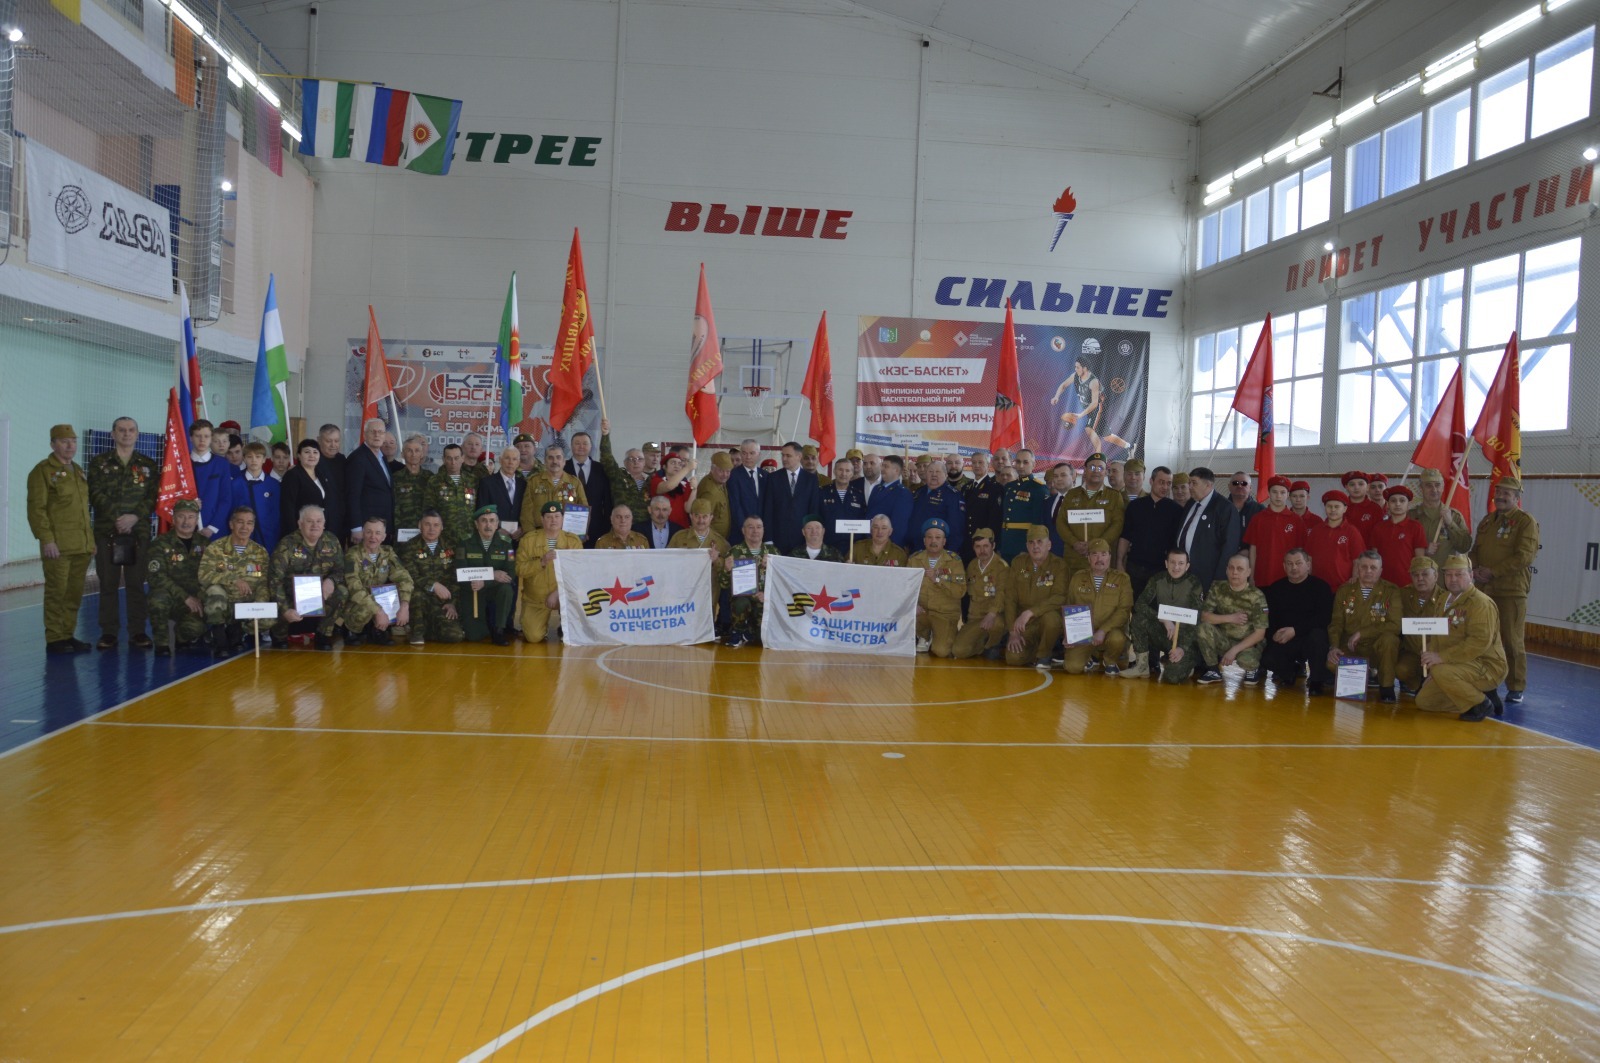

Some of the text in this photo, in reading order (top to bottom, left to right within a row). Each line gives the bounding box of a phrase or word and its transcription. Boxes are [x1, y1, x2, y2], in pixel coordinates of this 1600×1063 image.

[452, 131, 602, 167] ТРЕЕ
[664, 201, 854, 240] ВЫШЕ
[99, 202, 166, 257] ALGA
[1285, 234, 1384, 292] ПРИВЕТ
[934, 276, 1173, 318] СИЛЬНЕЕ
[878, 366, 969, 376] «КЭС-БАСКЕТ»
[925, 386, 965, 394] ШКОЛЬНОЙ
[881, 395, 941, 403] БАСКЕТБОЛЬНОЙ
[424, 408, 441, 417] 64
[865, 411, 994, 423] «ОРАНЖЕВЫЙ МЯЧ»
[427, 422, 439, 430] 16
[446, 423, 470, 431] 500
[609, 601, 695, 620] ЗАЩИТНИКИ
[609, 616, 687, 632] ОТЕЧЕСТВА
[811, 615, 897, 632] ЗАЩИТНИКИ
[809, 627, 887, 644] ОТЕЧЕСТВА
